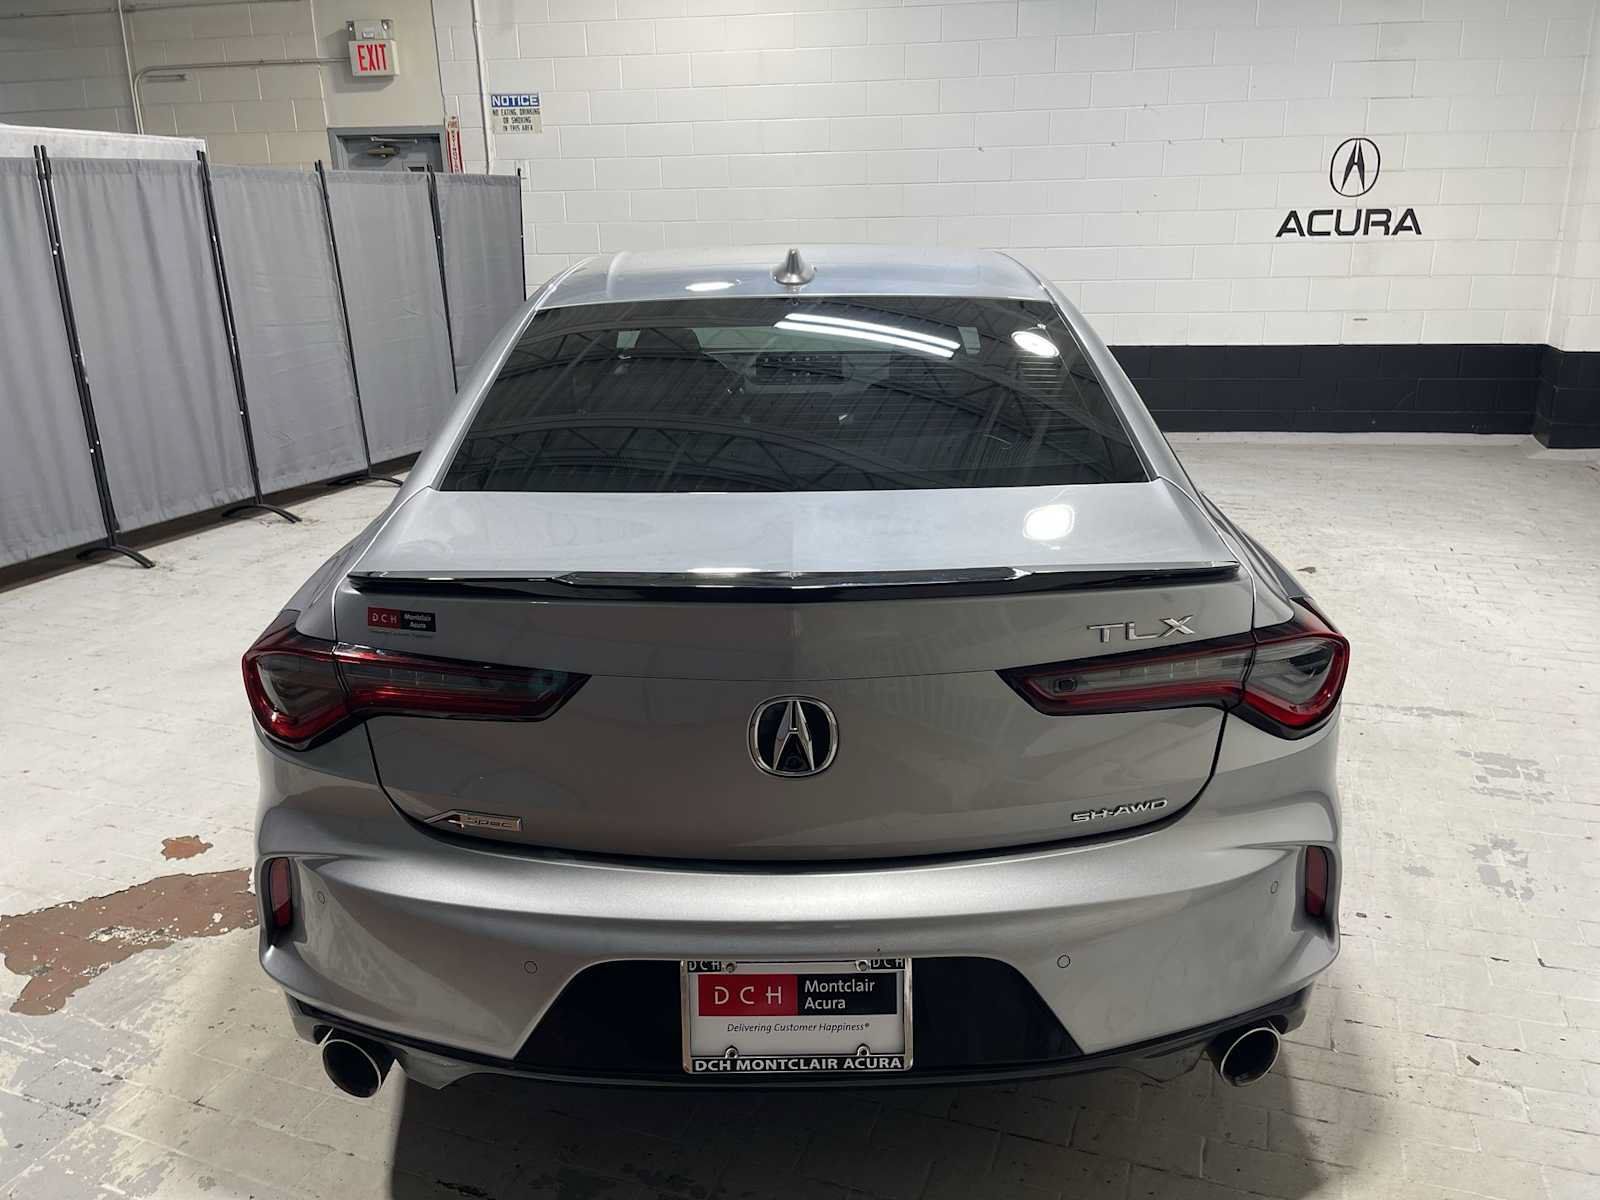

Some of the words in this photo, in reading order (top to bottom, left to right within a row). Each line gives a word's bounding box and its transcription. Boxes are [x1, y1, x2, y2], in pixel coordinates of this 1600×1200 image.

[357, 44, 387, 71] EXIT
[491, 95, 539, 106] NOTICE
[1275, 208, 1422, 237] ACURA
[1087, 615, 1195, 643] TLX
[1071, 798, 1168, 822] SH-AWD
[804, 979, 875, 993] Montclair
[714, 986, 782, 1005] DCH
[804, 997, 847, 1010] Acura
[727, 1023, 772, 1034] Delivering
[773, 1023, 817, 1032] Customer
[695, 1060, 731, 1071] DCH
[736, 1058, 838, 1071] MONTCLAIR
[843, 1057, 902, 1069] ACURA
